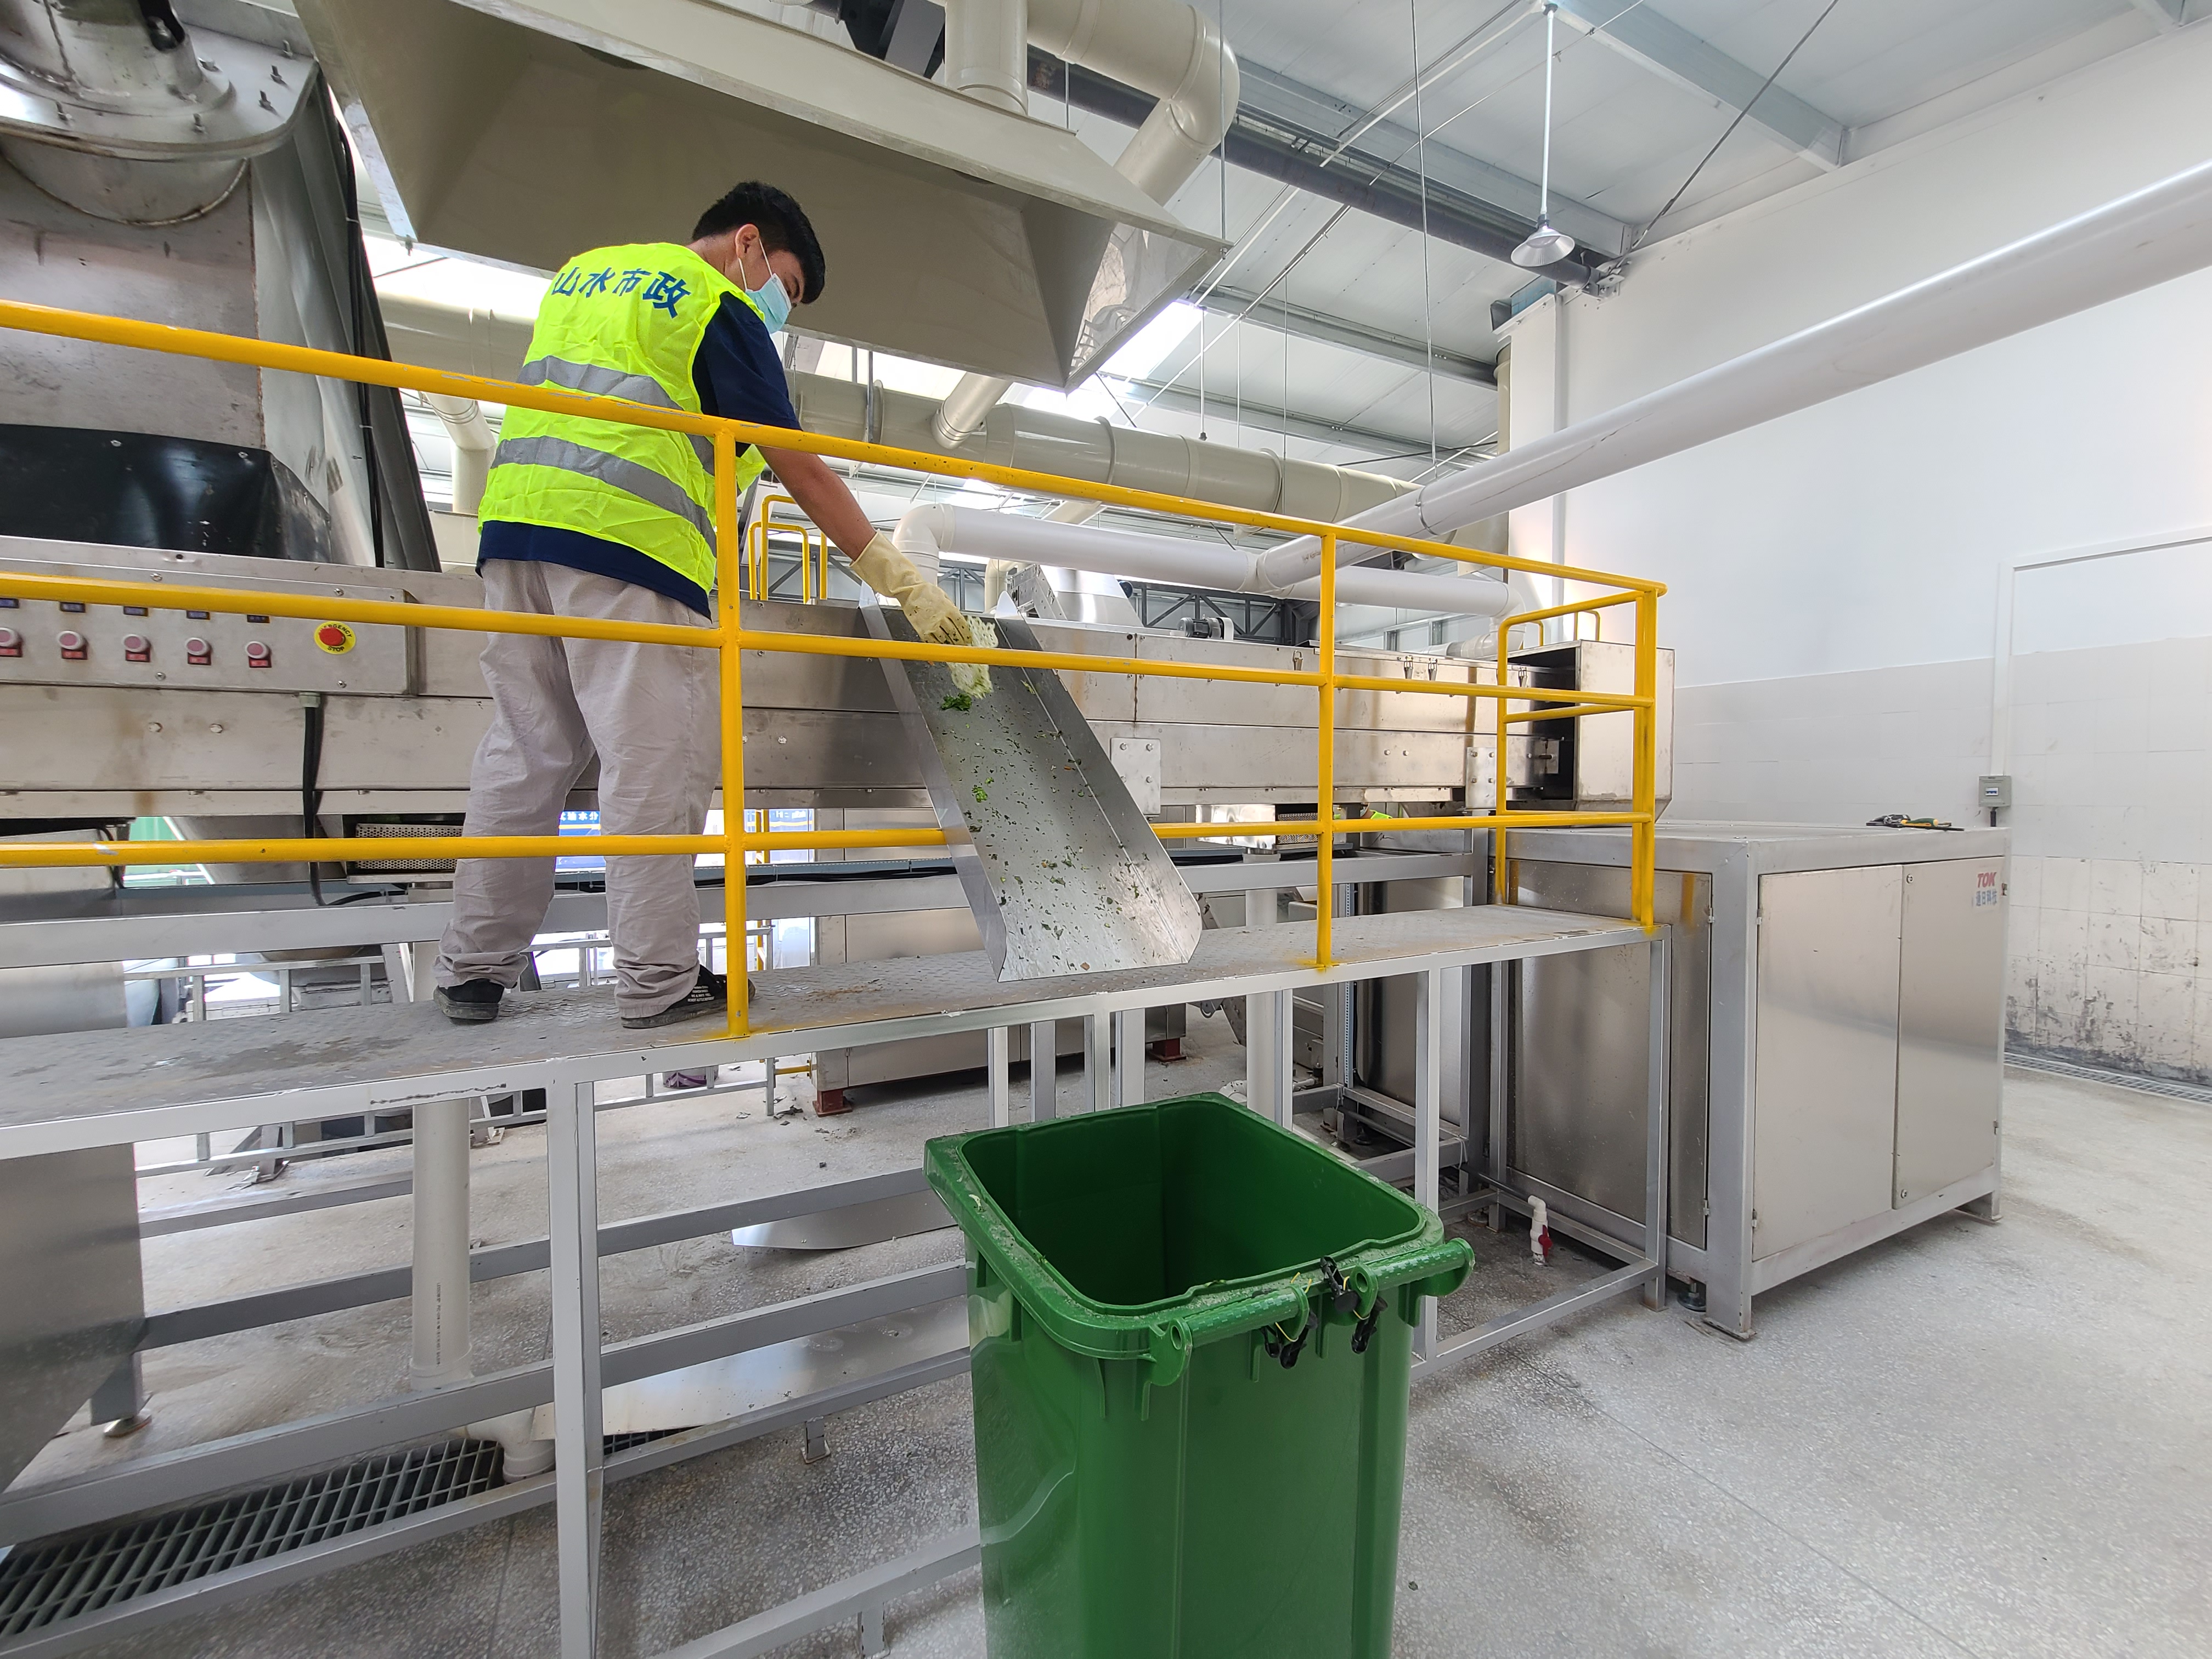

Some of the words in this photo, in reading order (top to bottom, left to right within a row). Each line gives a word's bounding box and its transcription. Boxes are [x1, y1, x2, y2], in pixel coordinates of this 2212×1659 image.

[551, 267, 691, 319] 山水市政
[1977, 872, 1997, 888] TOK
